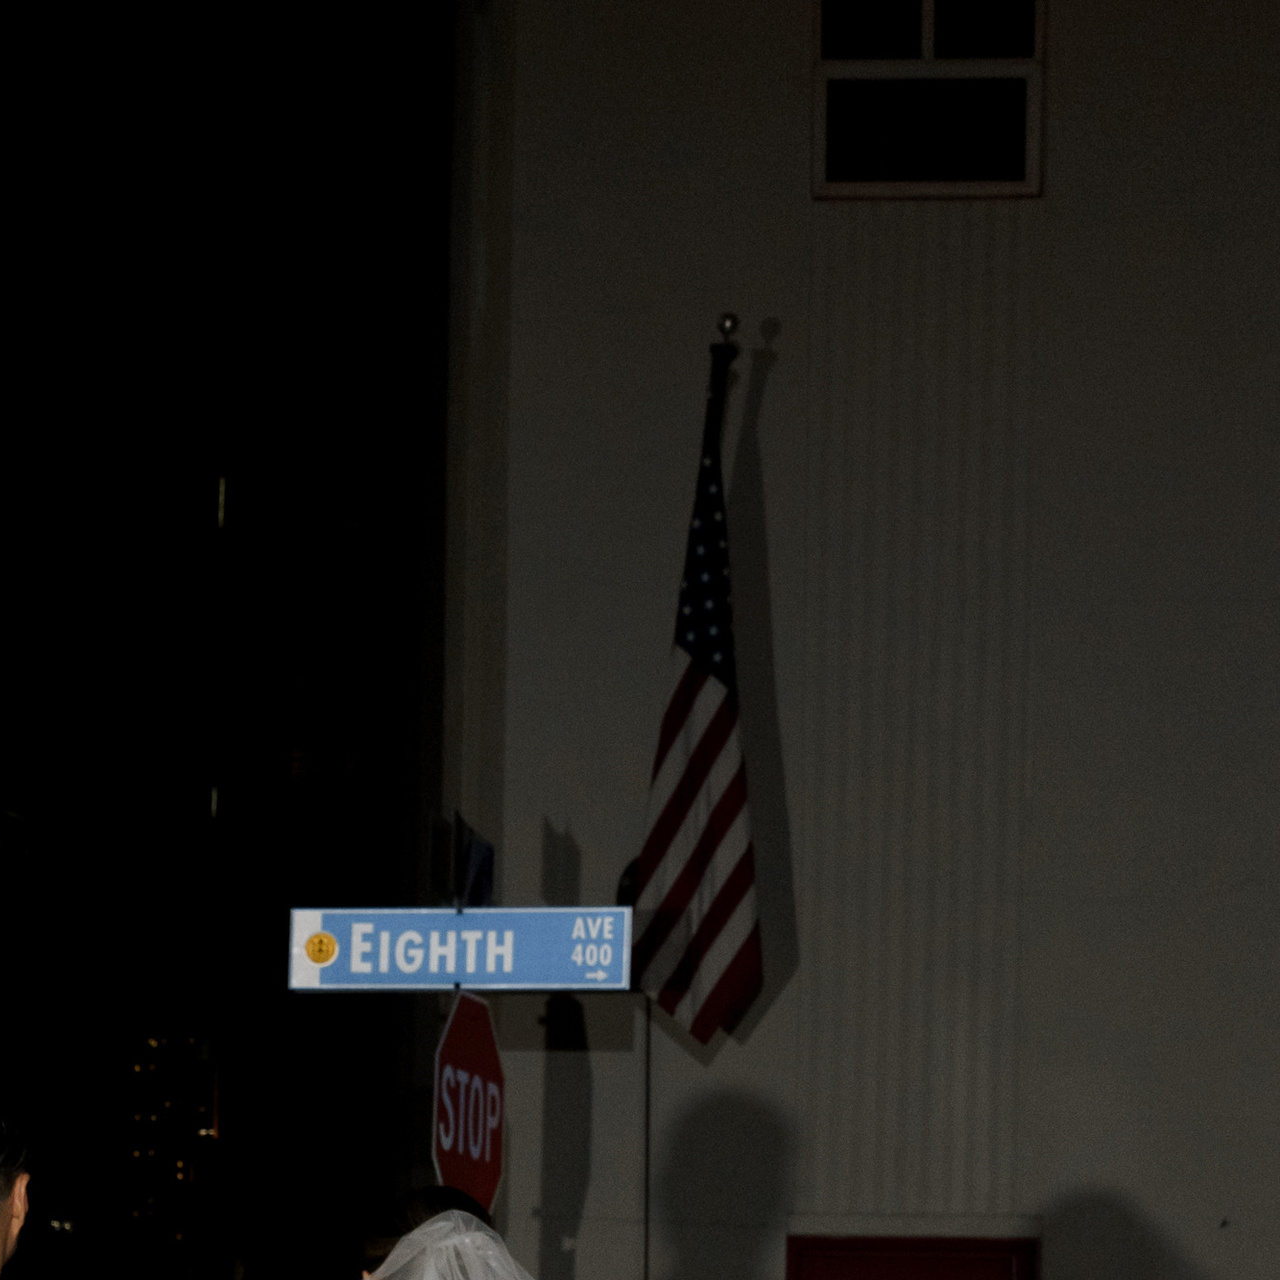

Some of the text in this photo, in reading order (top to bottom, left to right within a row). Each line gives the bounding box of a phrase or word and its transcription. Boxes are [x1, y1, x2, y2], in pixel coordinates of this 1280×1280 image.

[571, 916, 615, 940] AVE
[350, 922, 515, 974] EIGHTH
[571, 944, 613, 967] 400
[439, 1064, 501, 1163] STOP
